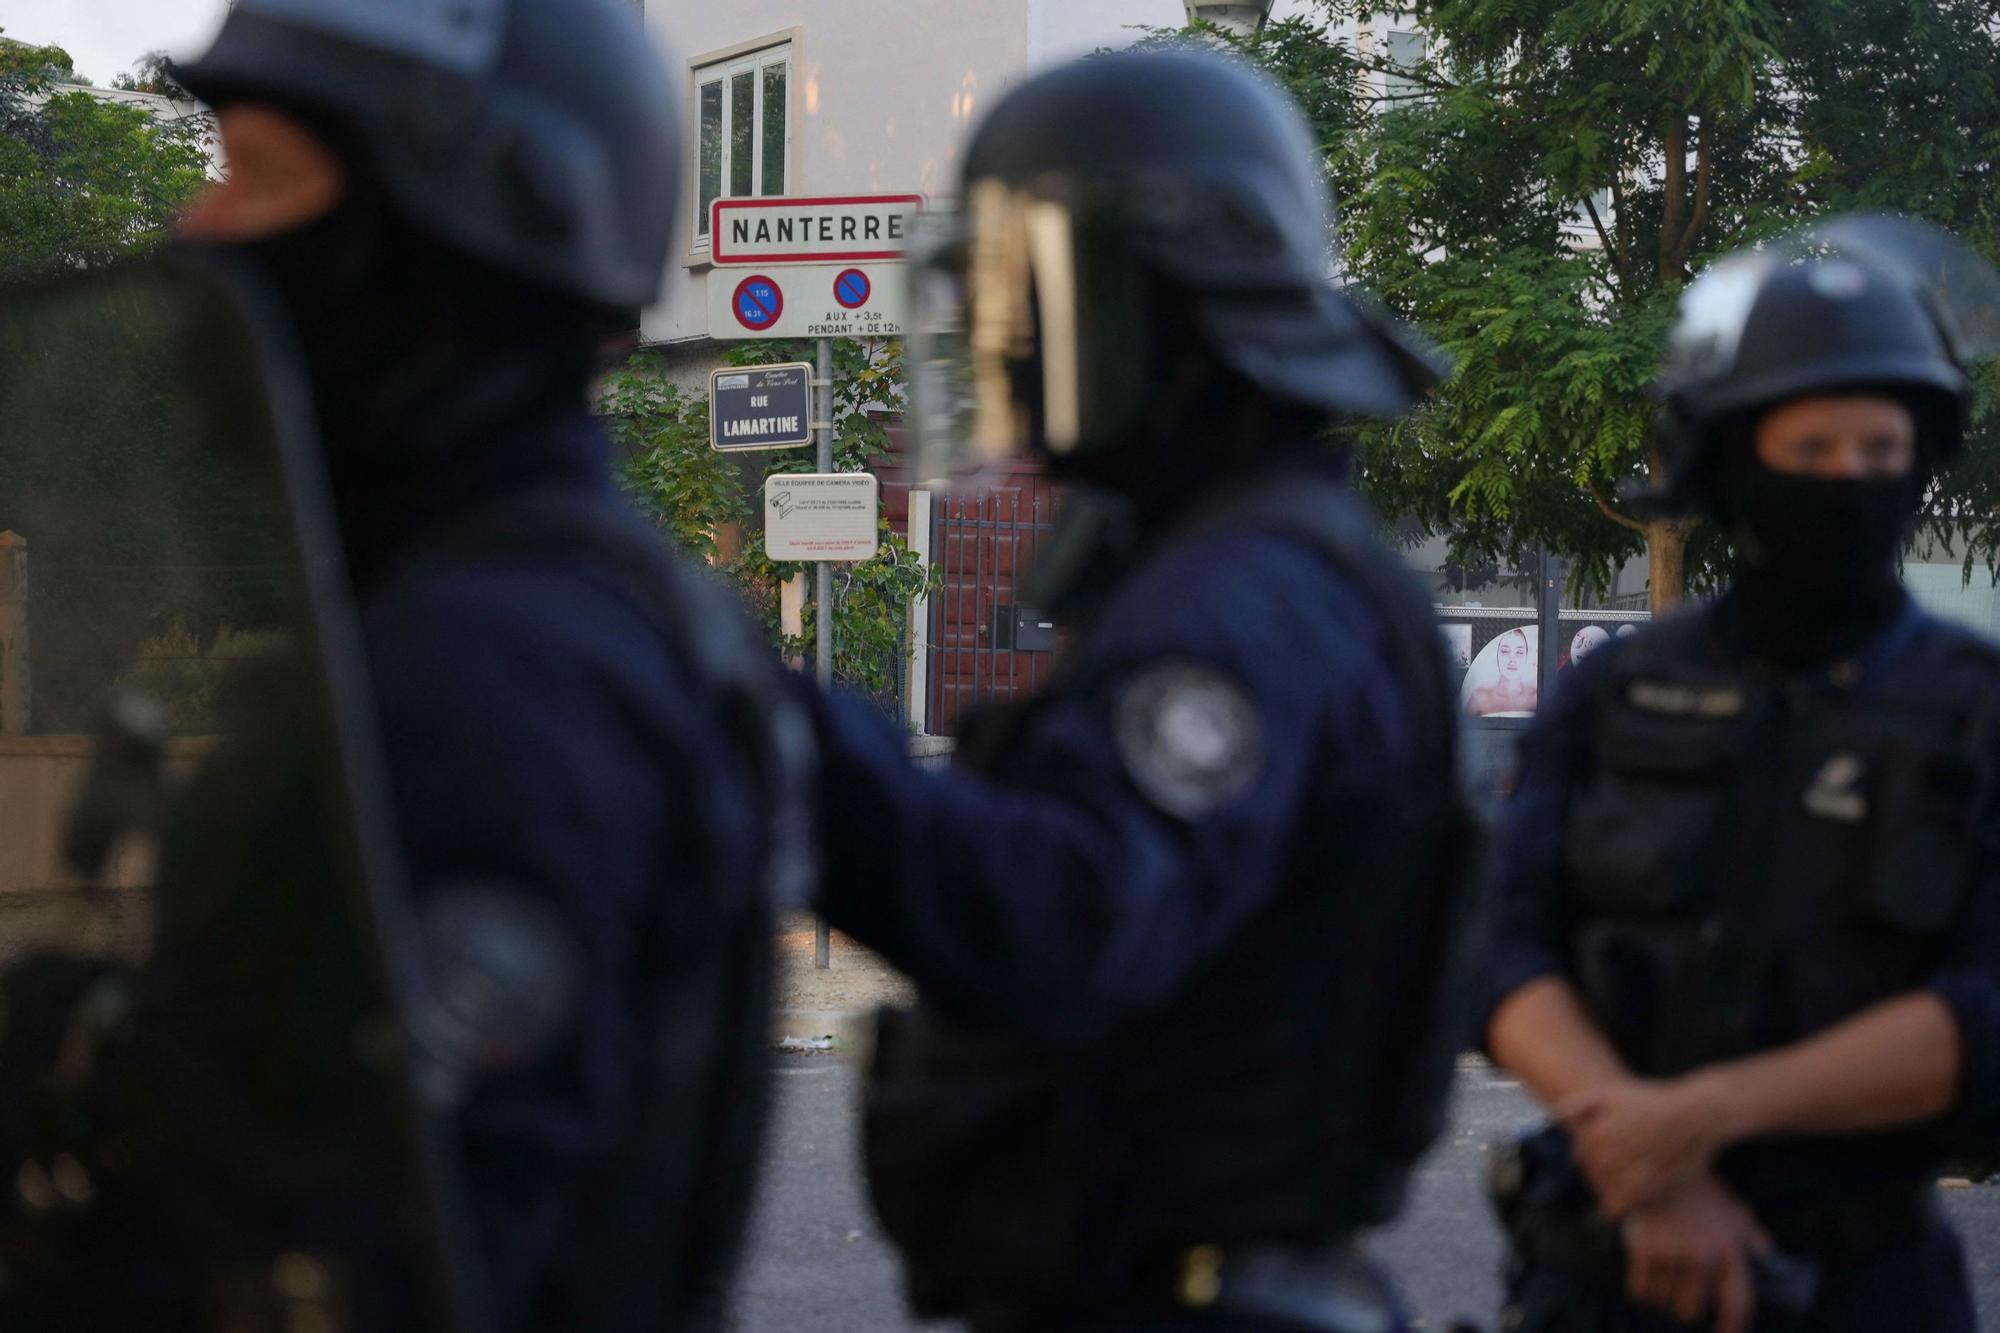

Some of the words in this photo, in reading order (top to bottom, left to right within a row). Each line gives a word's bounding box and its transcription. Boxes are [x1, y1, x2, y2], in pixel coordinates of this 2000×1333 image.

[733, 215, 904, 243] NANTERRE
[825, 312, 848, 321] AUX
[864, 311, 882, 321] 3,5t
[808, 324, 853, 334] PENDANT
[867, 323, 880, 333] DE
[883, 322, 901, 333] 12h
[750, 395, 768, 407] RUE
[724, 416, 799, 436] LAMARTINE
